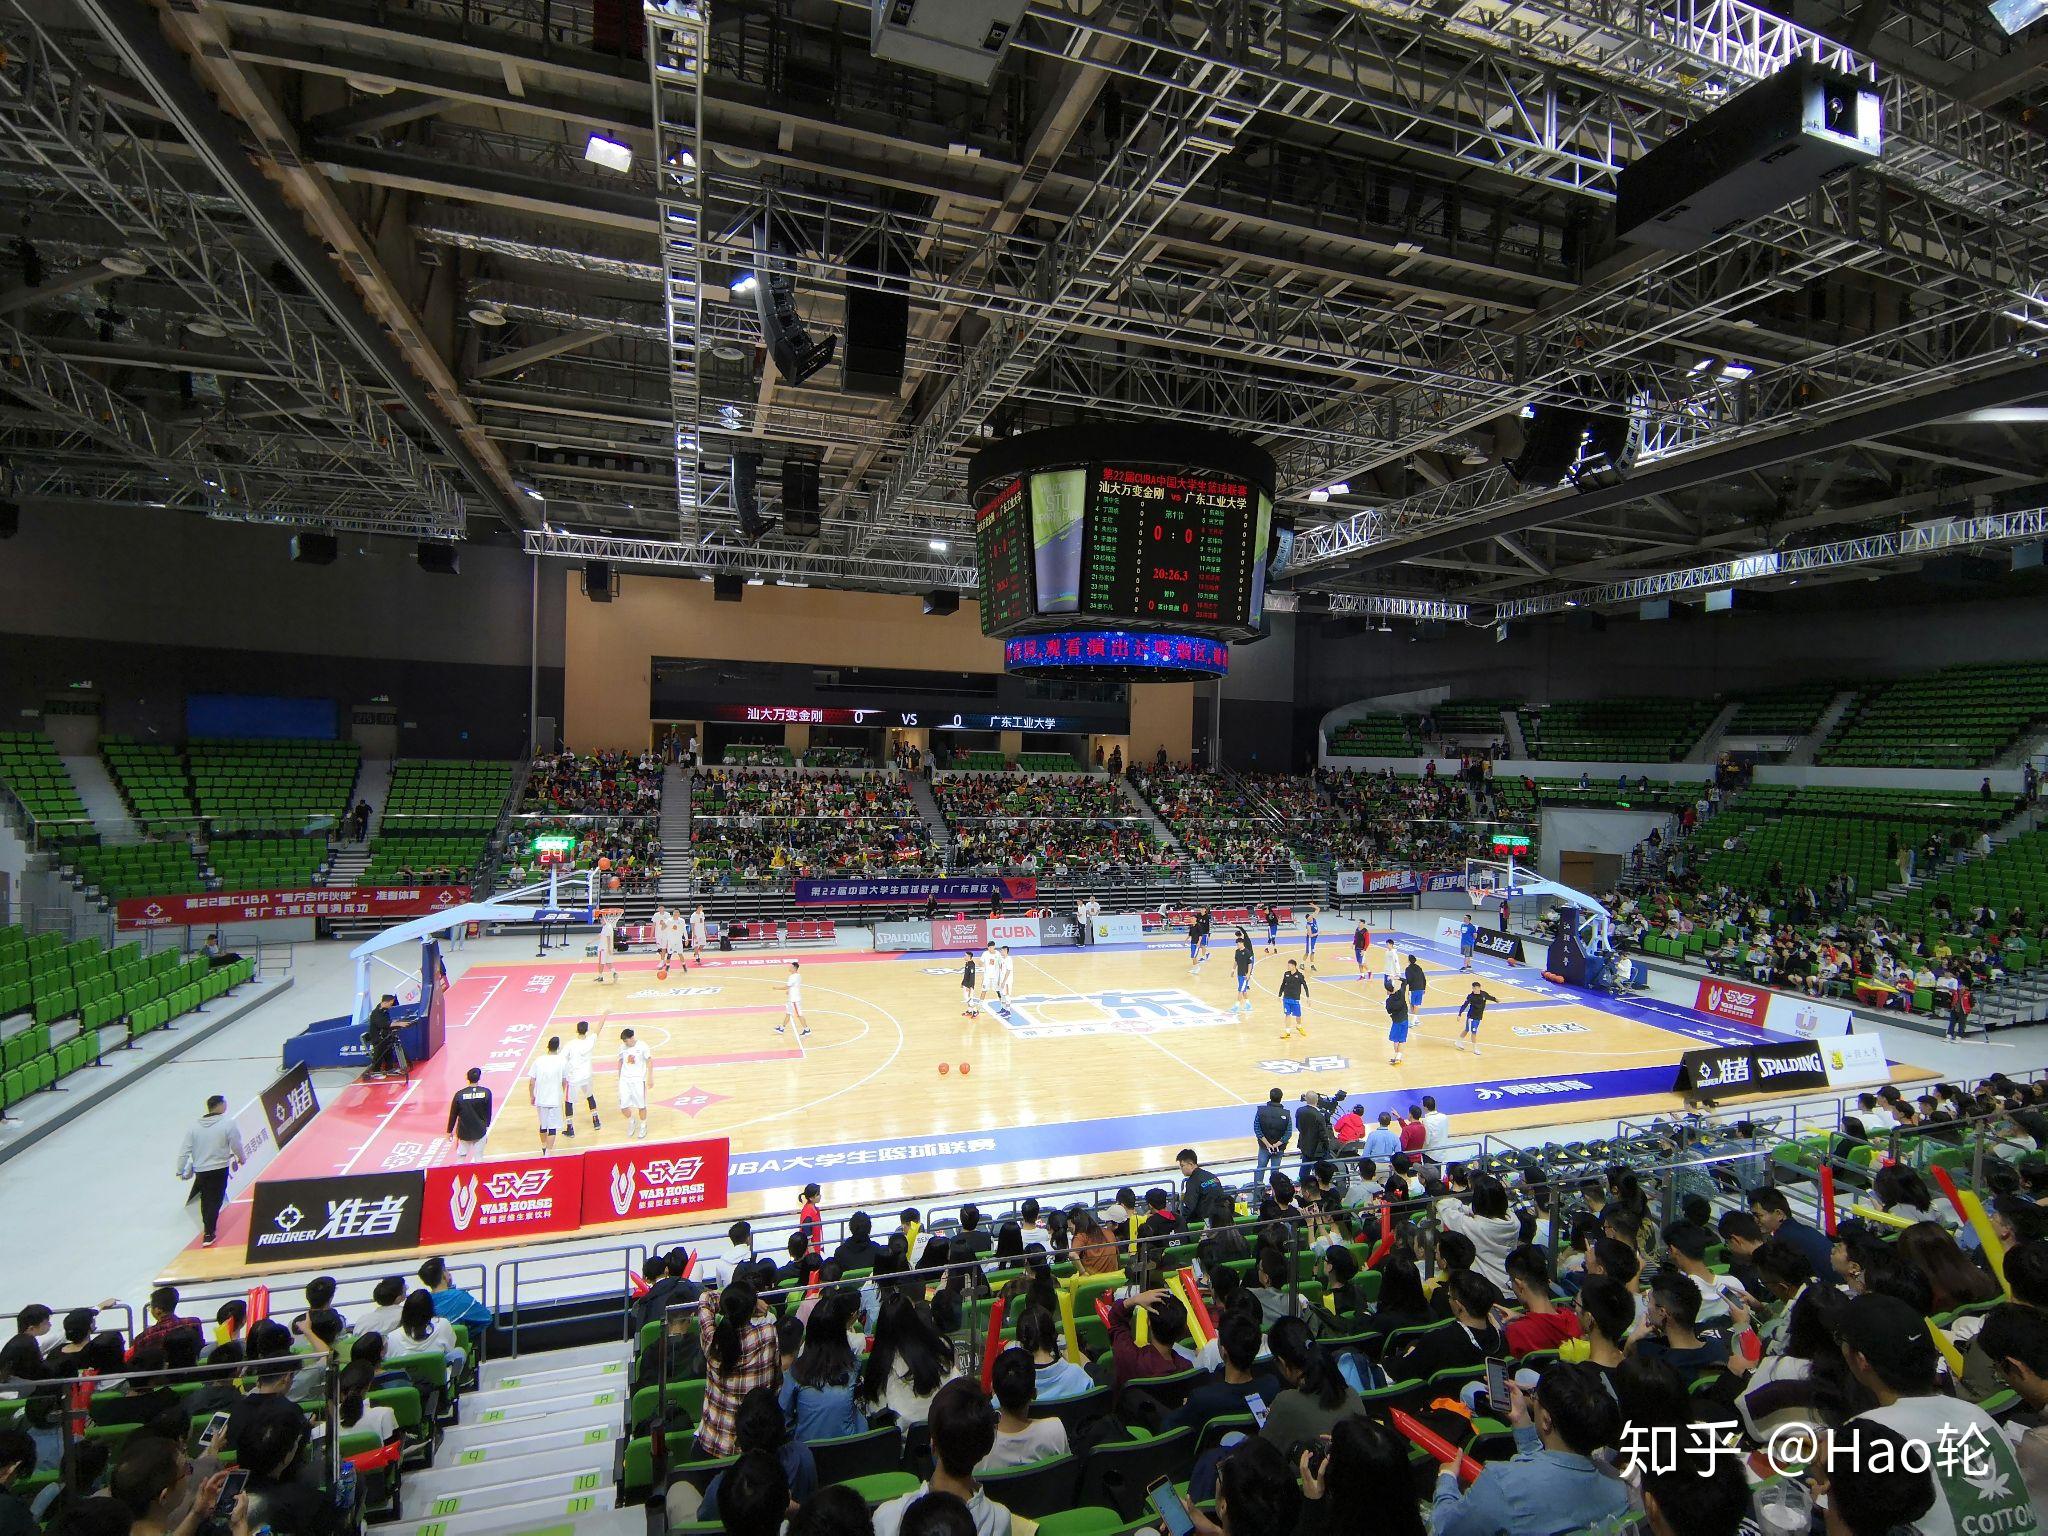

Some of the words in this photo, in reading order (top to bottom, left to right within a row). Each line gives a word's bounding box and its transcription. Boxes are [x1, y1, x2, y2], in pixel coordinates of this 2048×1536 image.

[1099, 481, 1165, 500] 汕大万变金刚
[1185, 491, 1247, 510] 广东工业大学
[1153, 525, 1162, 541] 0
[1185, 529, 1193, 544] 0
[1153, 568, 1188, 581] 20:26.3
[1148, 600, 1155, 610] 0
[1182, 603, 1189, 613] 0
[747, 707, 823, 723] 汕大万变金刚
[854, 711, 863, 724] 0
[902, 713, 918, 726] VS
[953, 714, 962, 727] 0
[990, 716, 1056, 730] 广东工业大学
[876, 931, 930, 945] SPALDING
[992, 925, 1036, 939] CUBA
[1717, 1056, 1750, 1083] 准者
[1757, 1052, 1824, 1078] SPALDING
[287, 1079, 313, 1121] 准者
[673, 1095, 709, 1106] 22
[639, 1189, 665, 1200] WAR
[666, 1183, 705, 1197] HORSE
[481, 1203, 509, 1214] WAR
[509, 1198, 552, 1212] HORSE
[638, 1195, 705, 1210] 能量型维生素饮料
[315, 1195, 409, 1240] 准者
[480, 1210, 551, 1225] 能量型维生素饮料
[257, 1229, 317, 1246] RIGORER
[469, 1451, 479, 1461] 9
[592, 1430, 600, 1440] 9
[438, 1498, 457, 1515] 10
[578, 1474, 595, 1489] 10
[425, 1524, 439, 1536] 11
[575, 1497, 588, 1512] 11
